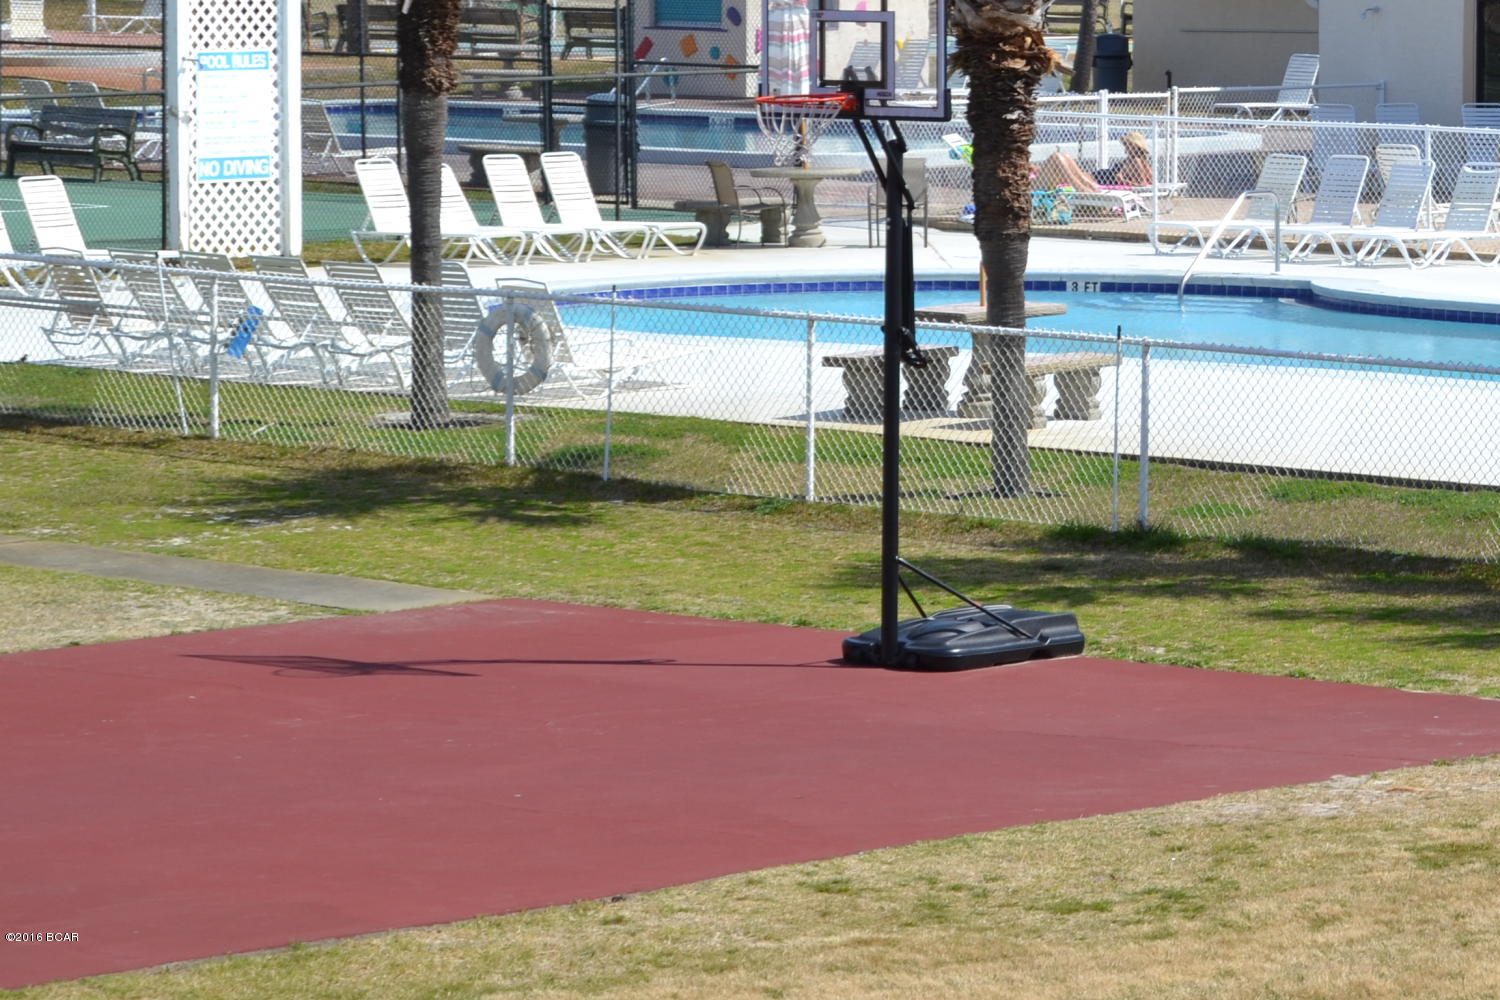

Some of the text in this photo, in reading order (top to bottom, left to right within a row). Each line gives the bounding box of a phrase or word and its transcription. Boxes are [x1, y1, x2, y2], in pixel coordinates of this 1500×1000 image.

[199, 54, 266, 68] POOL RULES
[199, 159, 269, 178] NO DIVING
[1071, 281, 1098, 292] 3 FT
